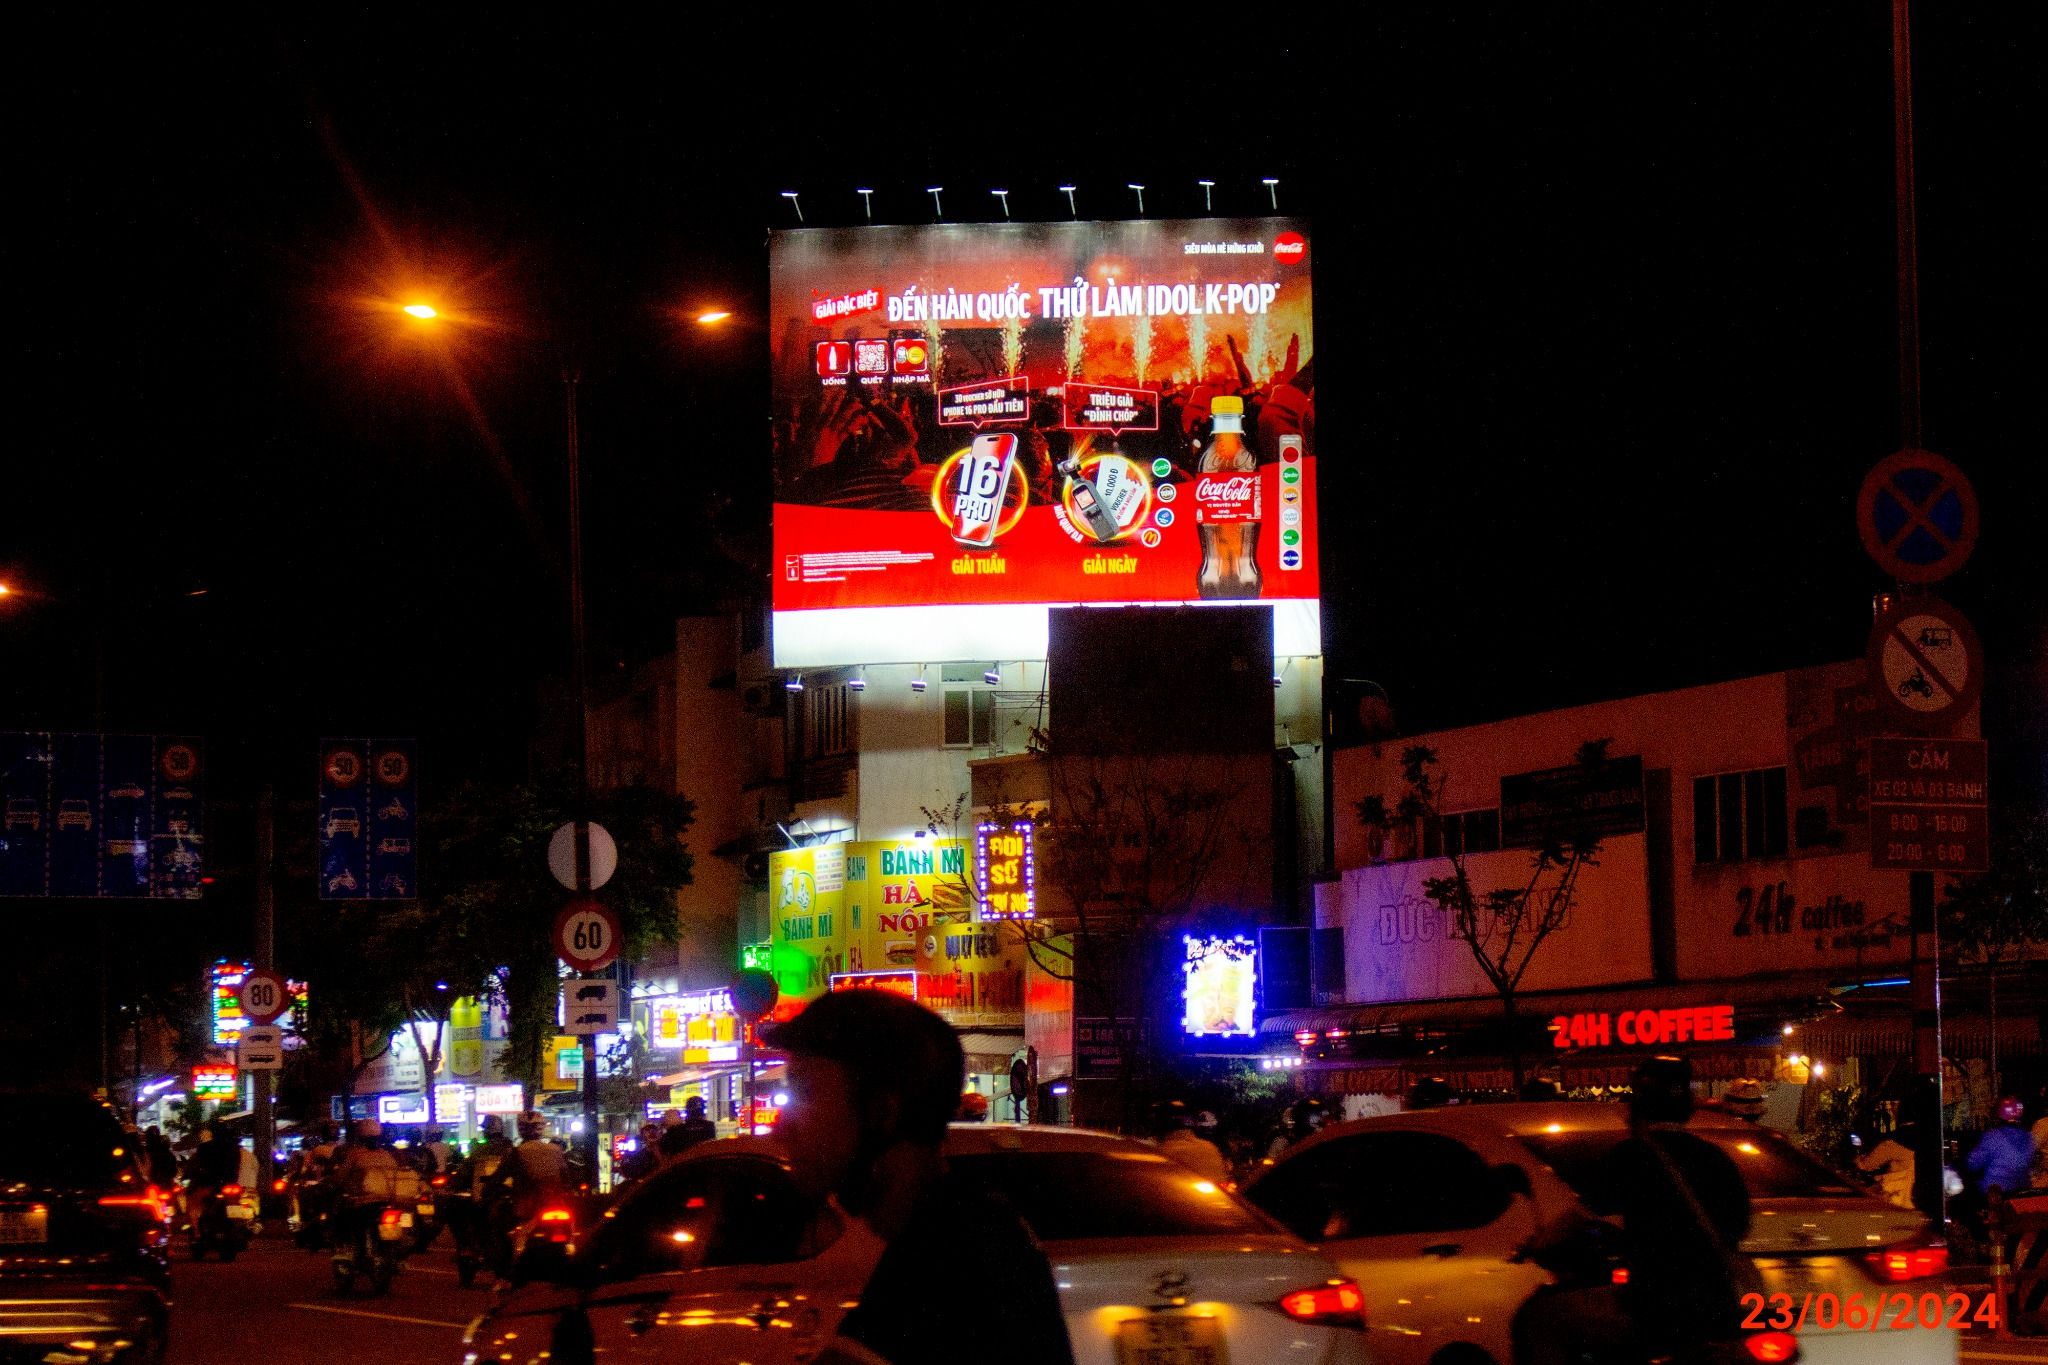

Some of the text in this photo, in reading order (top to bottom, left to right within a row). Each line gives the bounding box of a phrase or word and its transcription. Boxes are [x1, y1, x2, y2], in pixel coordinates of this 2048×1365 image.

[816, 290, 879, 319] GIẢI ĐẶC BIỆT
[888, 285, 927, 322] ĐẾN
[932, 287, 972, 320] HÀN
[976, 282, 1031, 321] QUỐC
[1039, 276, 1089, 318] THỬ
[1092, 278, 1141, 317] LÀM
[1148, 283, 1203, 316] IDOL
[822, 376, 846, 385] UỐNG
[861, 375, 883, 384] QUÉT
[893, 373, 930, 384] NHẬP MÃ
[943, 406, 964, 417] IPHONE
[965, 405, 973, 415] 16
[973, 404, 987, 415] PRO
[1004, 398, 1024, 412] TIÊN
[1090, 391, 1133, 409] TRIỆU GIẢI
[957, 455, 1001, 499] 16
[1196, 477, 1254, 501] Coca-Cola
[955, 494, 993, 521] PRO
[952, 554, 974, 574] GIẢI
[975, 552, 1006, 574] TUẦN
[1083, 553, 1138, 574] GIẢI NGÀY
[1908, 743, 1950, 771] CẤM
[1874, 780, 1890, 796] XE
[881, 842, 965, 876] BÁNH MÌ
[882, 880, 923, 905] HÀ
[879, 907, 929, 937] NỘI
[1380, 895, 1436, 945] ĐỨC
[1734, 881, 1796, 937] 24h
[574, 921, 601, 950] 60
[784, 907, 832, 941] BÁNH MÌ
[251, 984, 273, 1007] 80
[1554, 1004, 1734, 1048] 24H COFFEE
